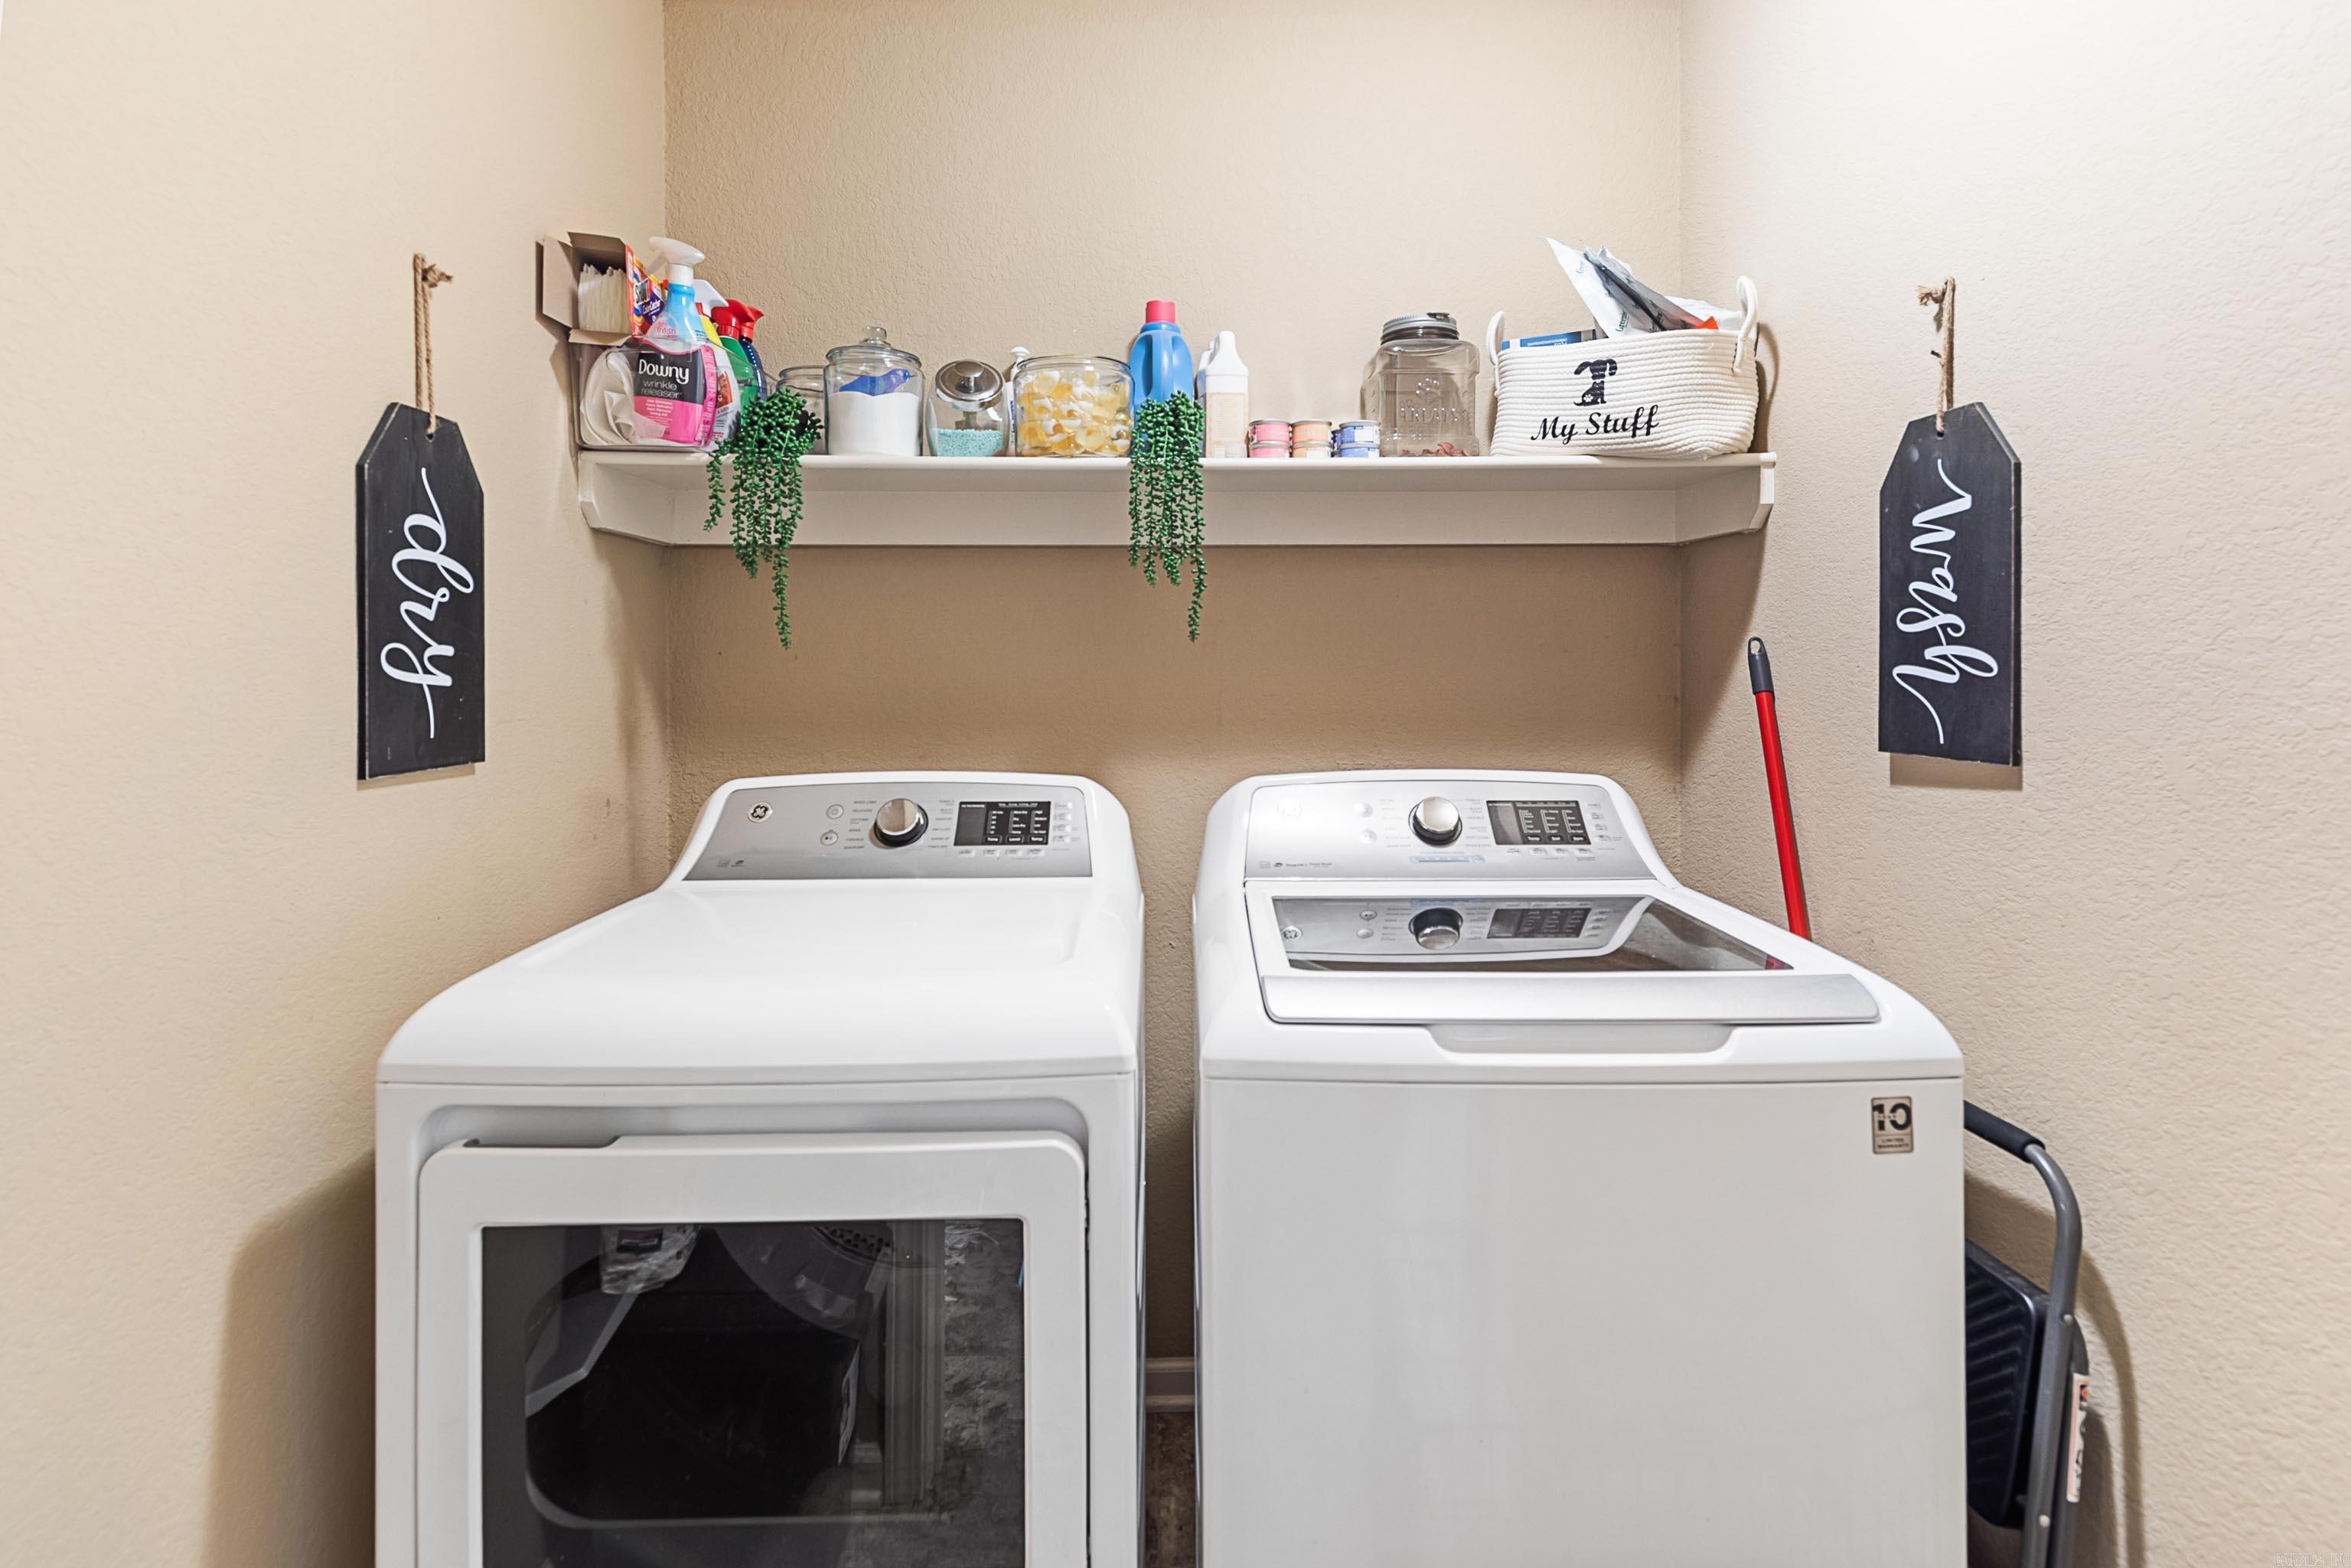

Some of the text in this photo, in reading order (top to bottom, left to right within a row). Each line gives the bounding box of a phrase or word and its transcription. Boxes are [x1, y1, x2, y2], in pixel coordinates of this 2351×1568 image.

[638, 359, 690, 385] Downy
[643, 380, 677, 391] wrinkle
[1530, 404, 1660, 445] My Stuff
[380, 467, 474, 739] dry
[1892, 458, 1999, 745] wash
[1873, 1102, 1912, 1131] 10
